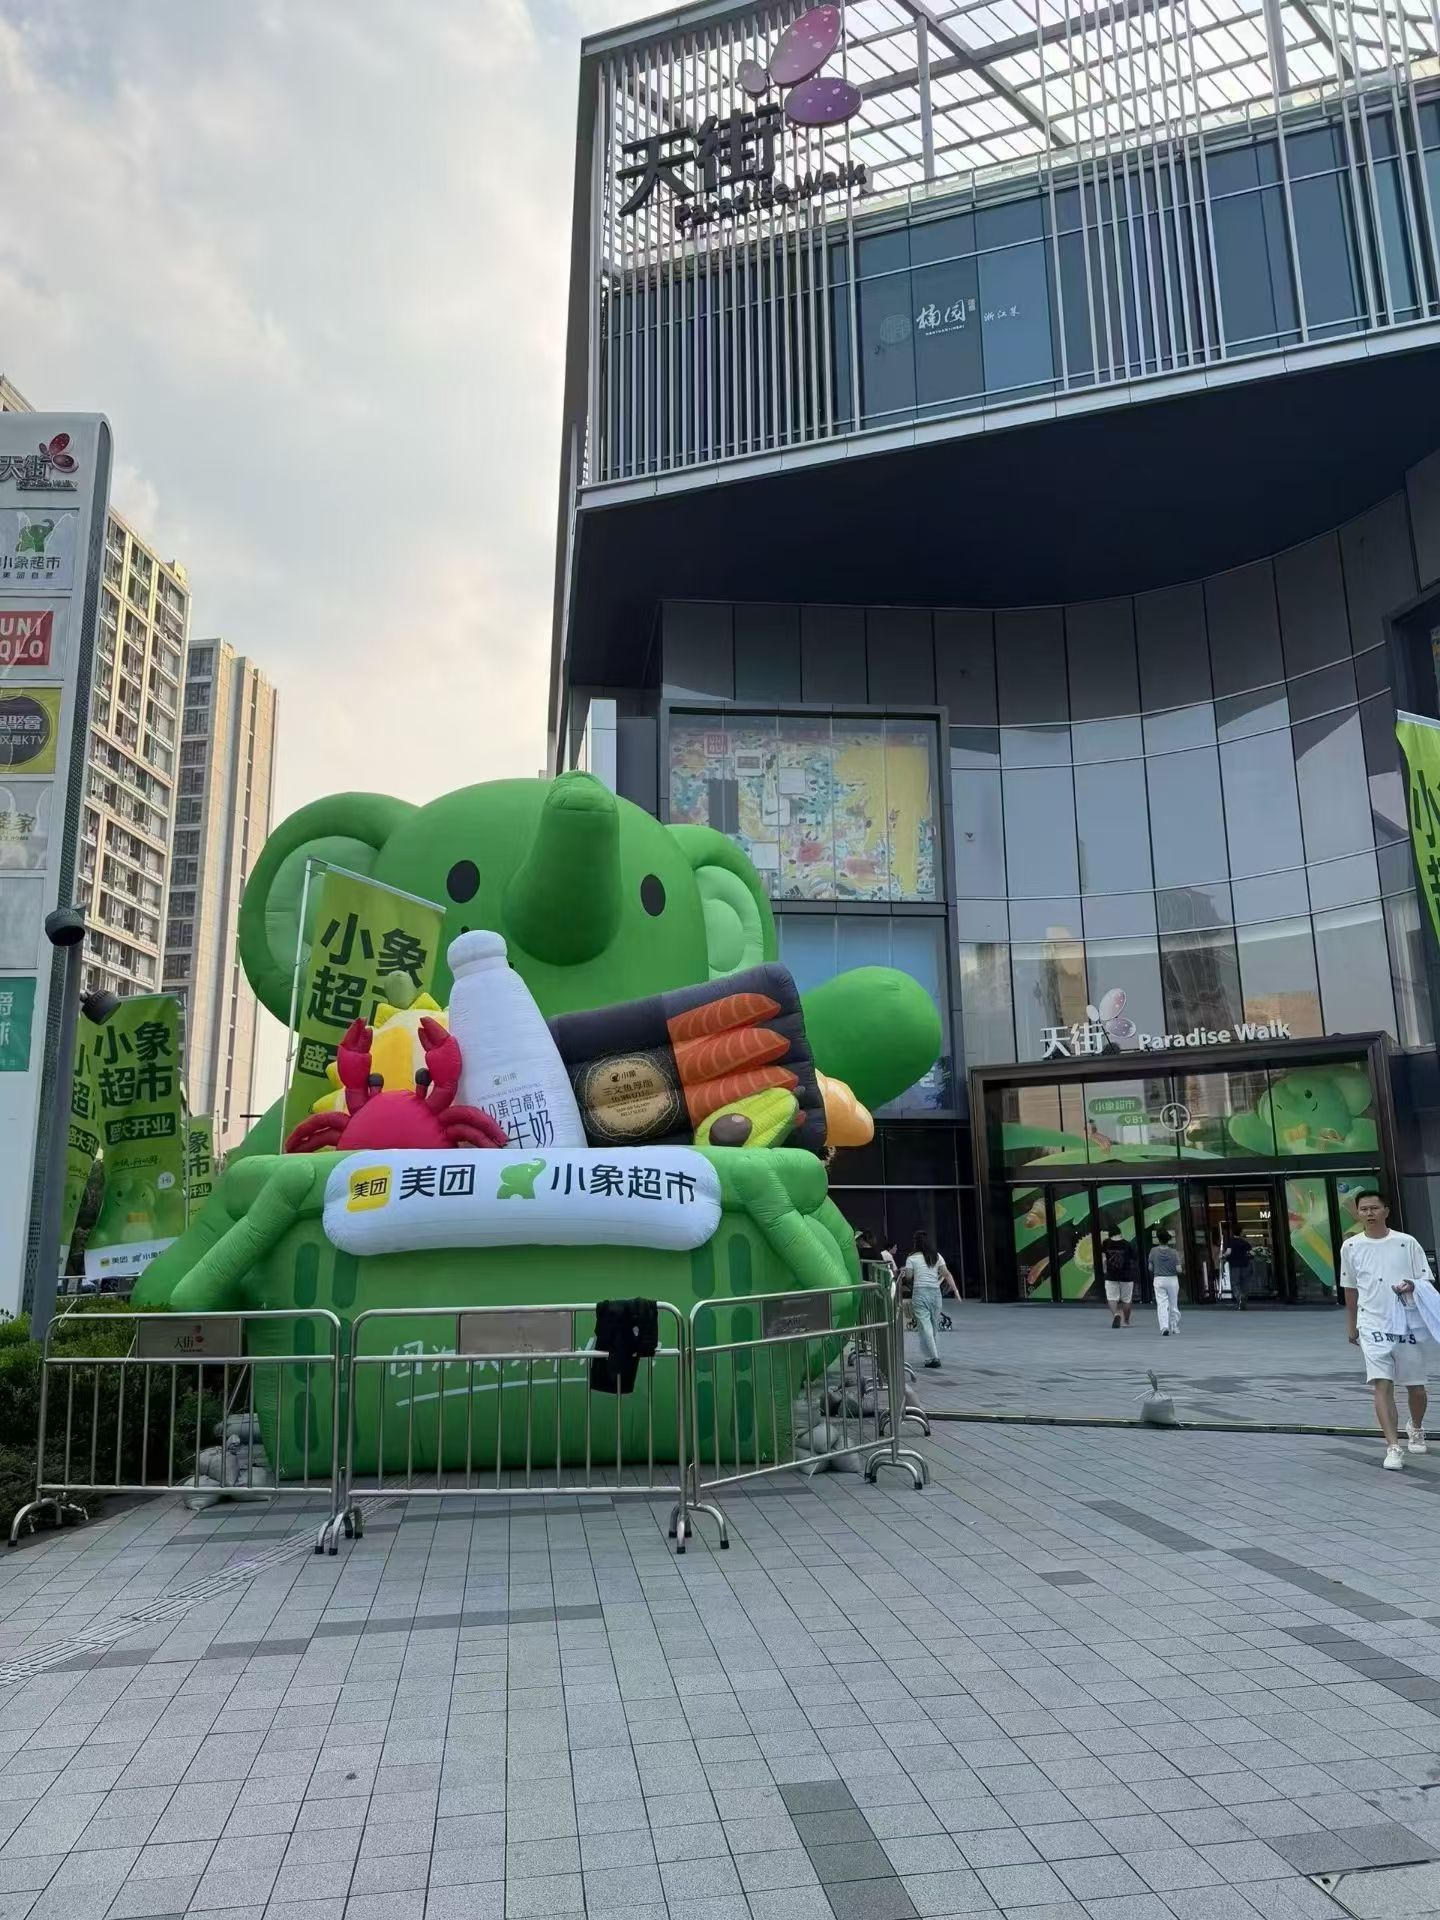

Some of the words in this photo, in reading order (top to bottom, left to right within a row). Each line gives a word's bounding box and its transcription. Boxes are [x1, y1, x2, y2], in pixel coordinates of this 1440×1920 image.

[616, 102, 783, 217] 天街
[795, 160, 867, 199] Walk
[0, 455, 52, 482] 天街
[0, 555, 61, 569] 小象超市
[0, 617, 42, 636] UNI
[0, 639, 44, 661] QLO
[320, 912, 427, 989] 小象
[94, 1021, 173, 1064] 小象
[1040, 1022, 1106, 1058] 天街
[1139, 1026, 1231, 1051] Paradise
[1234, 1019, 1292, 1041] Walk
[98, 1062, 174, 1107] 超市
[499, 1110, 554, 1149] 牛奶
[1169, 1108, 1178, 1127] 1
[352, 1178, 388, 1200] 美团
[399, 1164, 476, 1201] 美团
[550, 1163, 697, 1204] 小象超市
